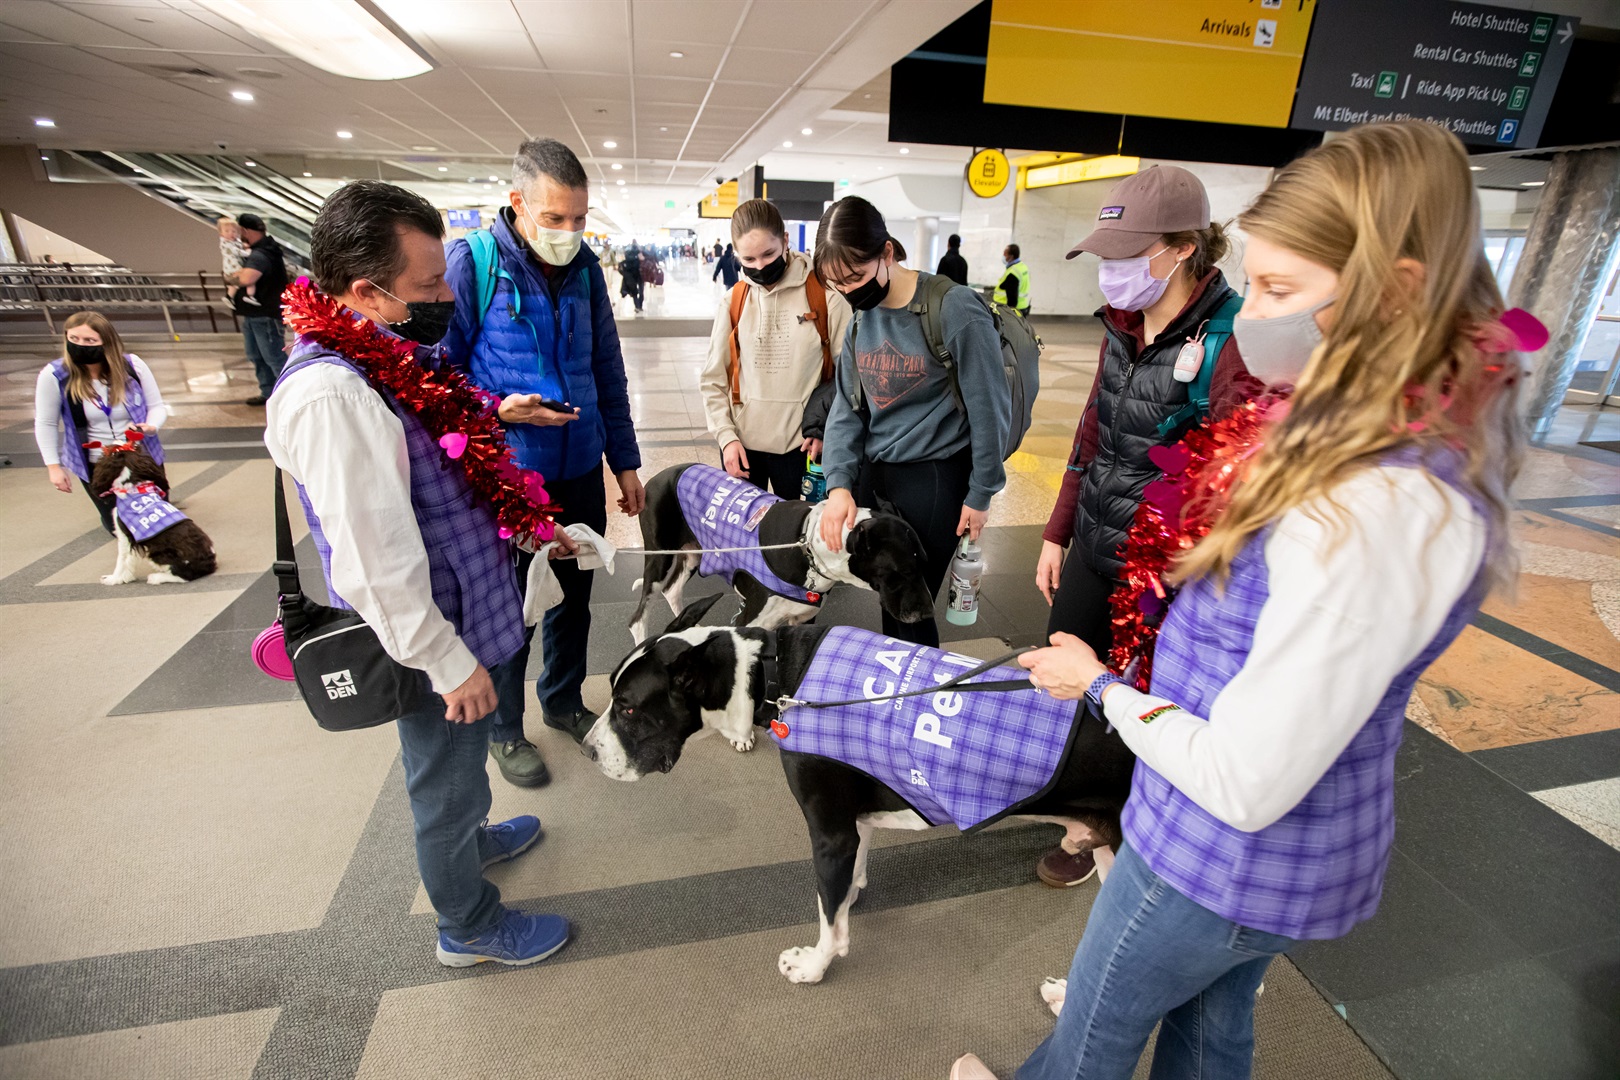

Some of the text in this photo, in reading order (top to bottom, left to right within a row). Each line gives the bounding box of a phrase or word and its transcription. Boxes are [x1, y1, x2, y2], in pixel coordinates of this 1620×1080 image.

[1200, 18, 1251, 38] Arrivals
[1450, 10, 1529, 34] Hotel Shuttles
[1413, 43, 1518, 69] Rental Car Shuttles
[1350, 72, 1376, 89] Taxi
[1416, 80, 1507, 105] Ride App Pick Up
[1314, 105, 1331, 120] Mt
[1334, 107, 1369, 124] Elbert
[1369, 111, 1394, 124] and
[1453, 117, 1496, 136] Shuttles
[974, 178, 1002, 187] Elevator
[902, 354, 926, 372] PARK
[139, 507, 166, 529] Pet
[701, 486, 732, 529] Me!
[903, 656, 921, 682] AIRPORT
[327, 684, 358, 701] DEN
[913, 671, 971, 748] Pet
